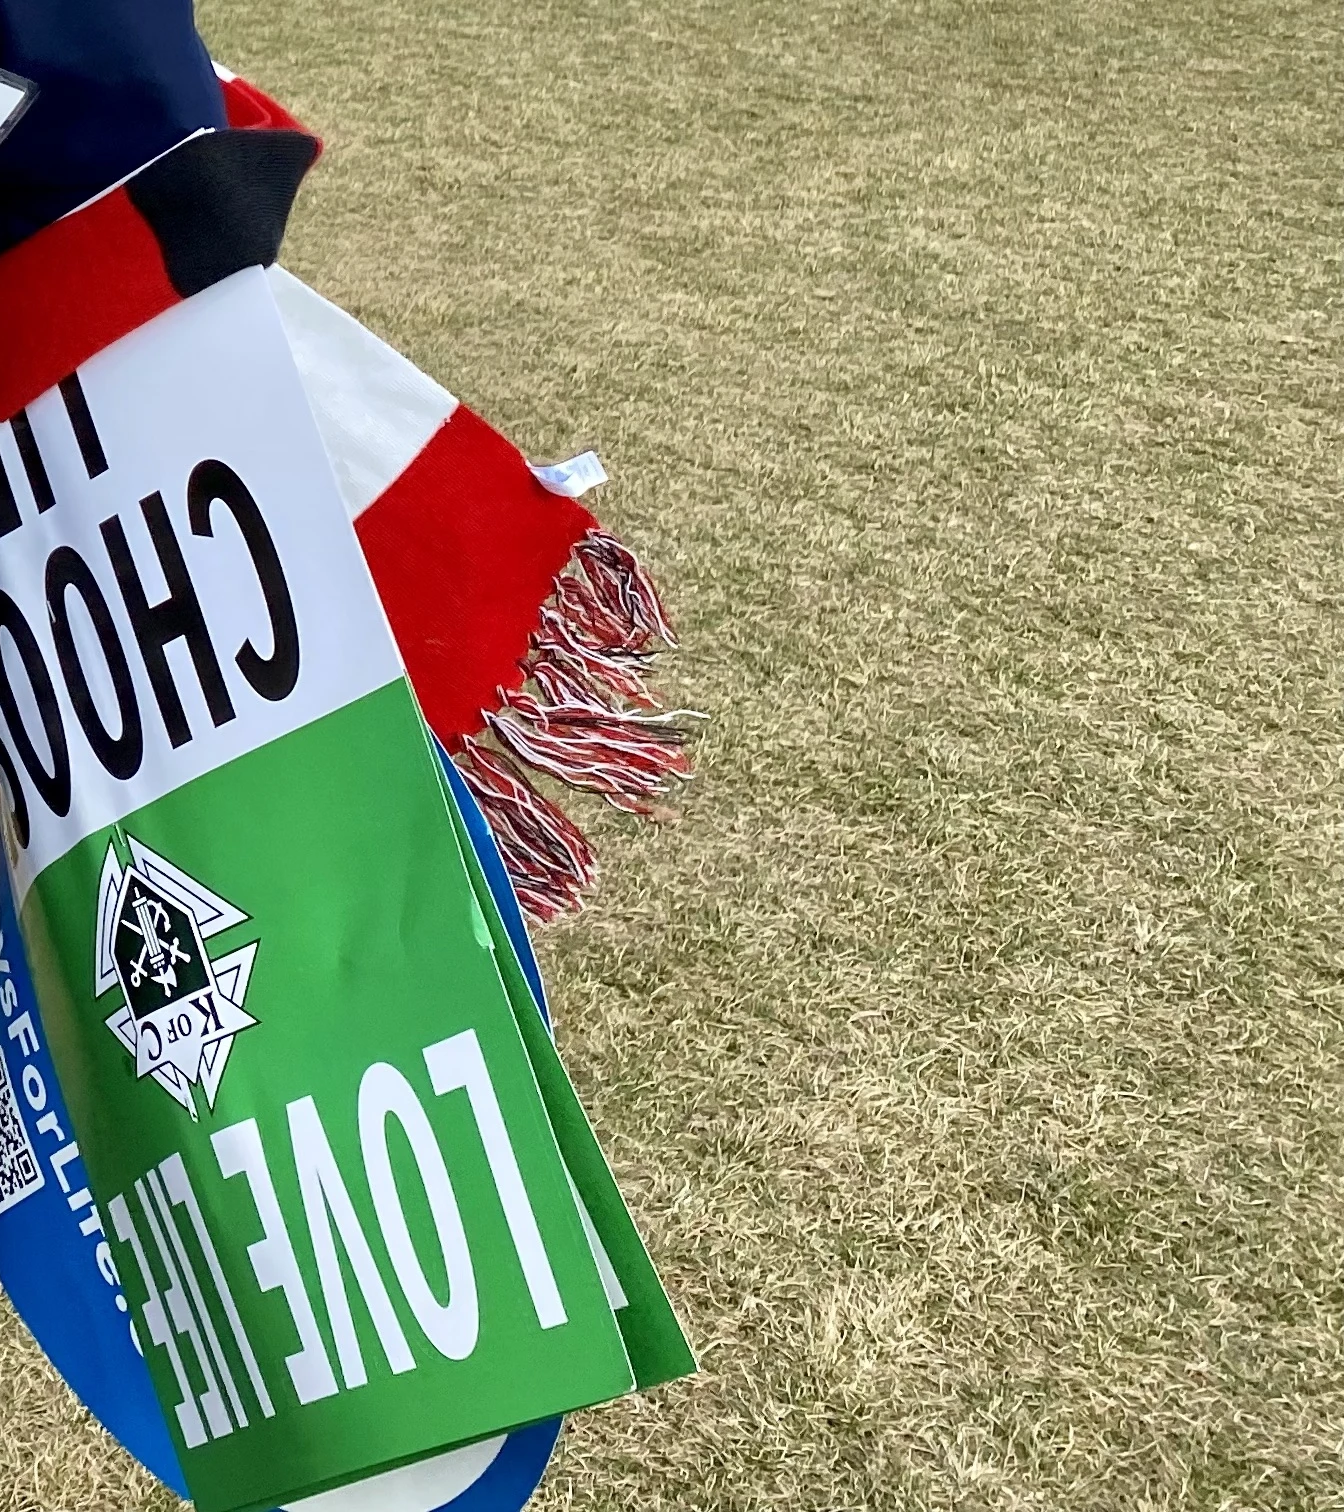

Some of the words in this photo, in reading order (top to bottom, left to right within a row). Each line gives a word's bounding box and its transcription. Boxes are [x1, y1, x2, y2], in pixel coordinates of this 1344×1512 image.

[140, 1021, 163, 1062] C
[189, 991, 224, 1038] K
[107, 1151, 275, 1449] LIFE
[211, 1029, 568, 1407] LOVE
